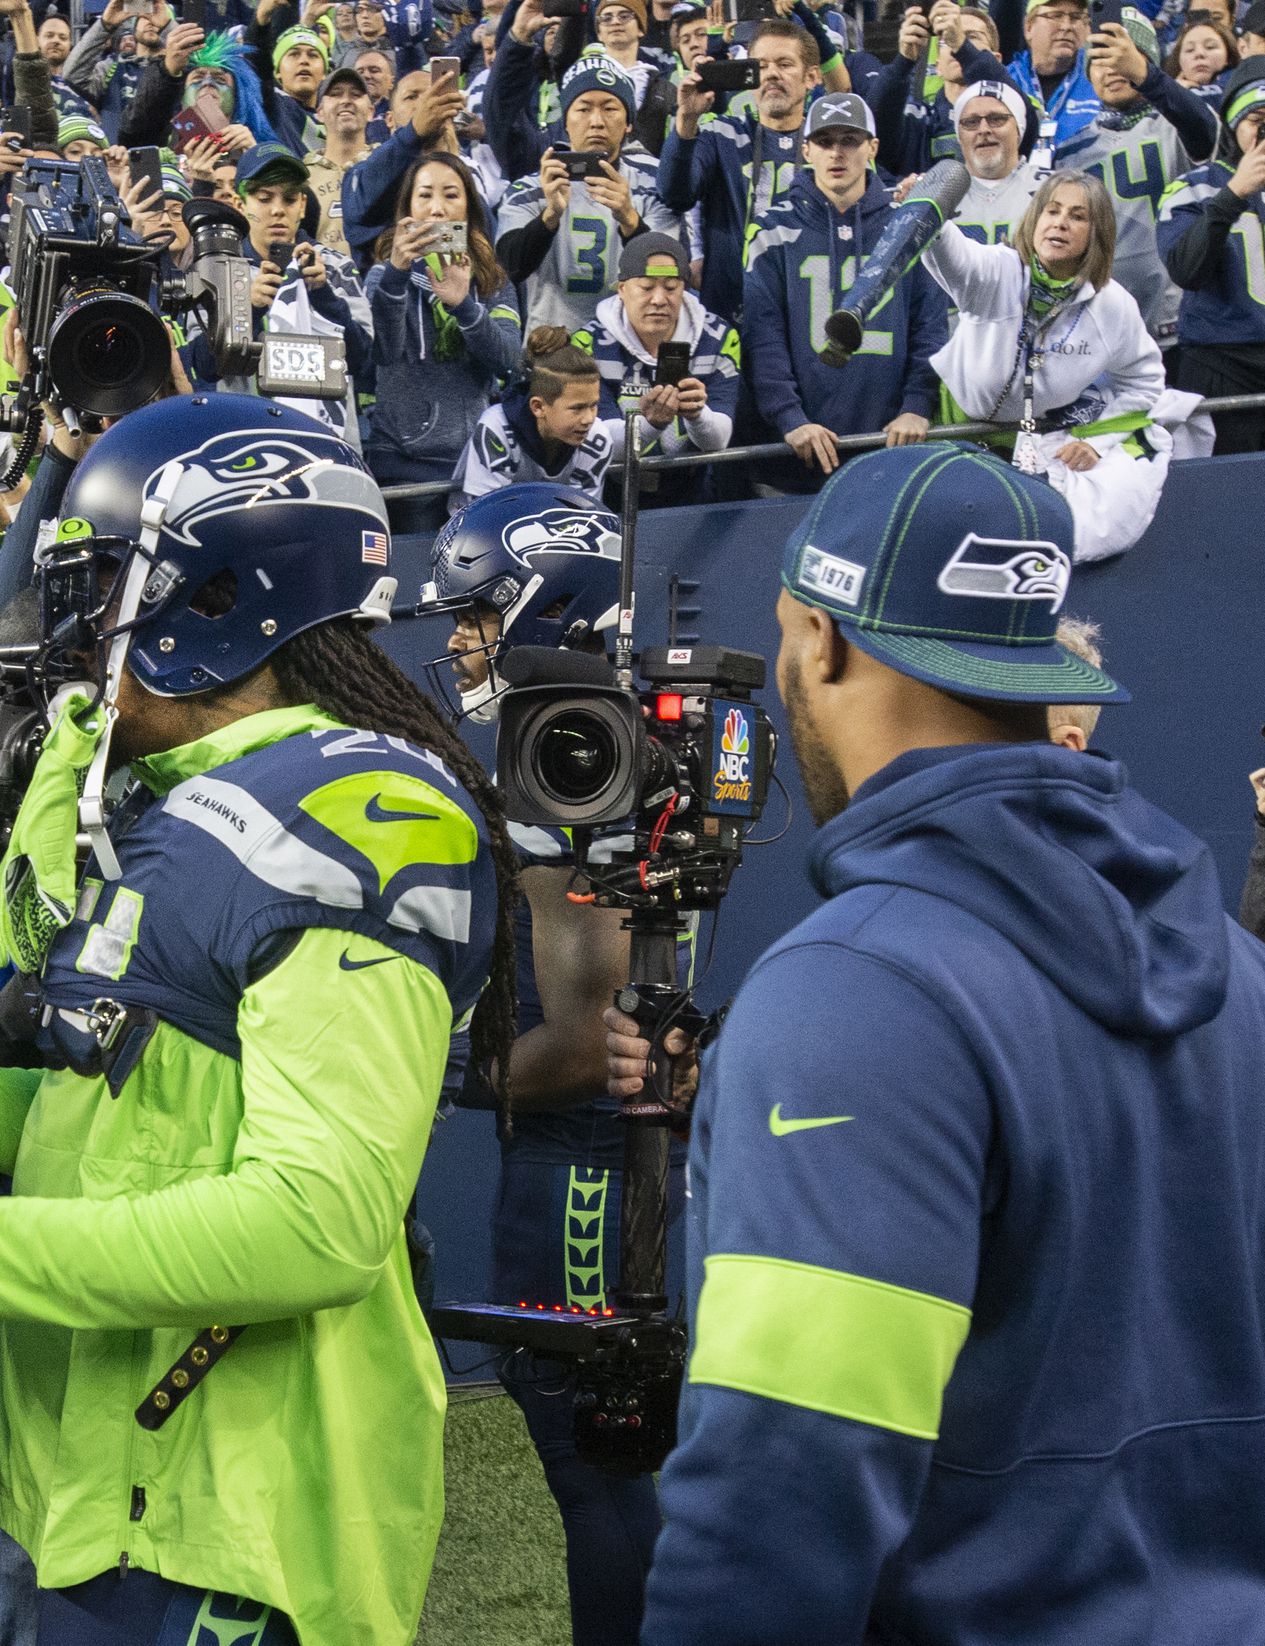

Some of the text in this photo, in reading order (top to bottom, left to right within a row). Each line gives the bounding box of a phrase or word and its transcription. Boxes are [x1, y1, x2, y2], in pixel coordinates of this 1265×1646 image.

[566, 214, 609, 293] 3
[271, 348, 321, 374] SDS
[821, 565, 855, 592] 1976
[719, 752, 749, 782] NBC
[713, 770, 752, 806] Sports
[185, 791, 248, 834] SEAHAWKS
